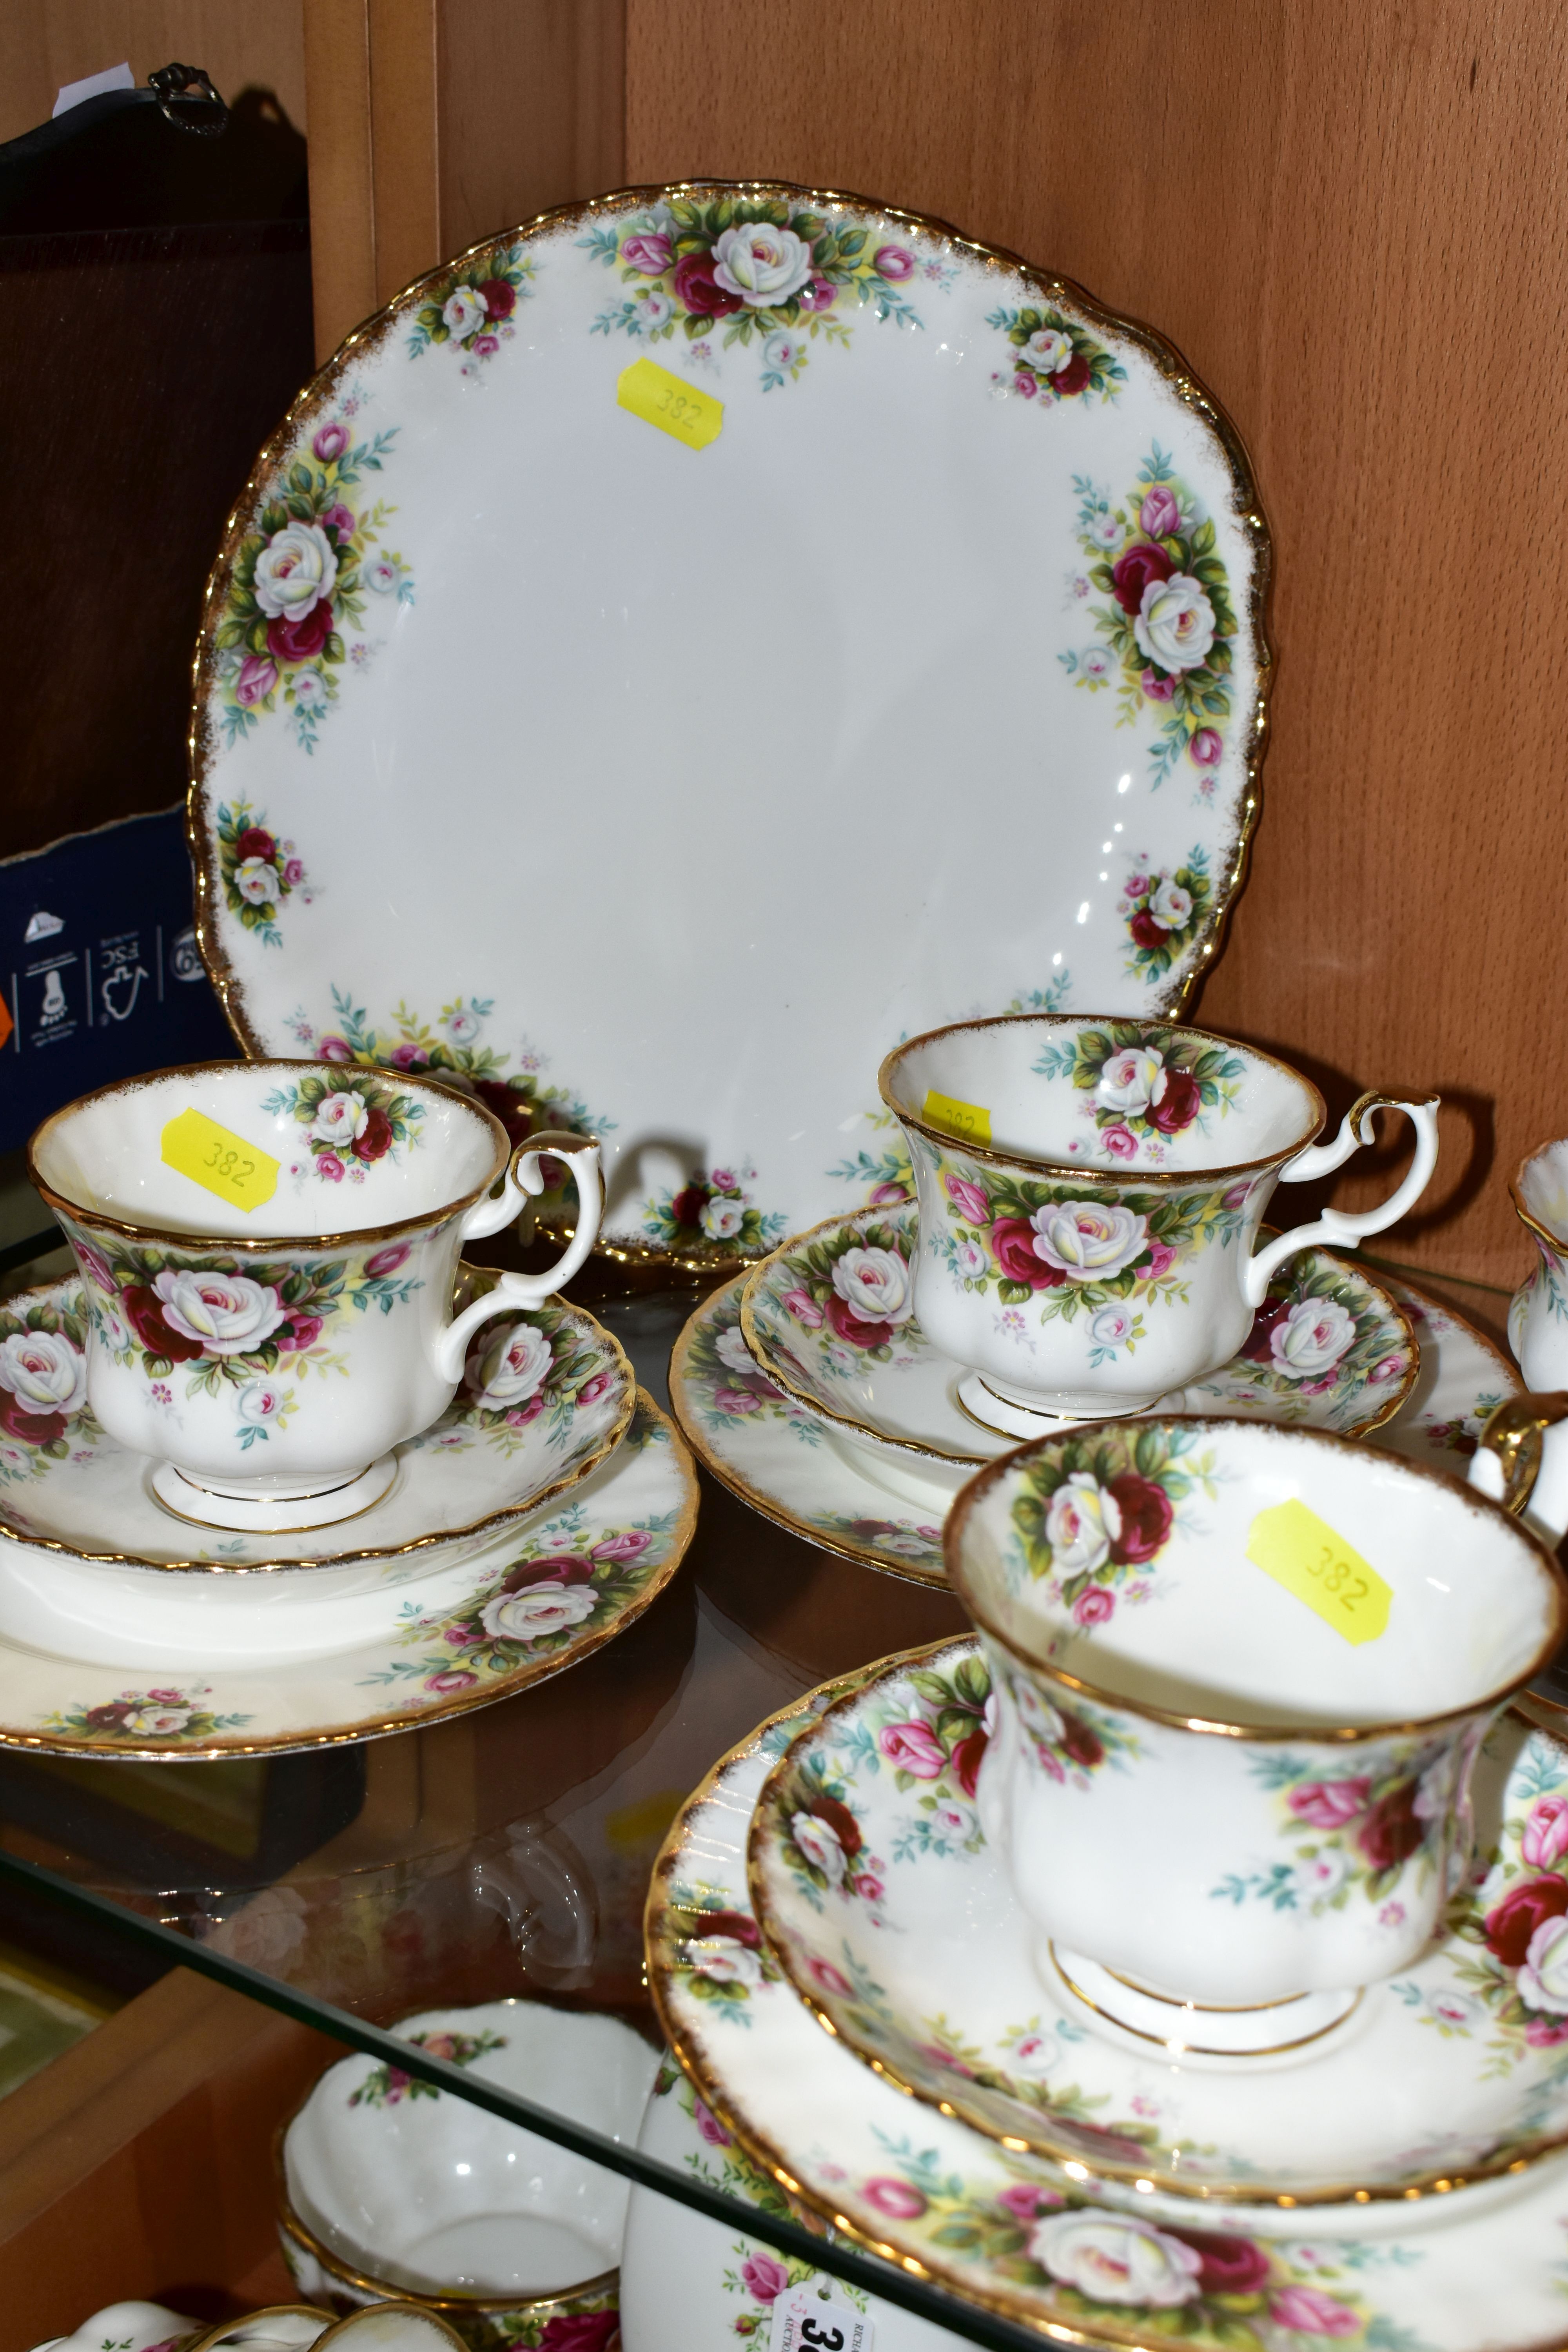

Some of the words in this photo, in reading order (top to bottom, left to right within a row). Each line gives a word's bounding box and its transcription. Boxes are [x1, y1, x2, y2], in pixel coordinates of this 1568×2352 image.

[656, 389, 702, 429] 382
[102, 941, 139, 969] FSC
[203, 1142, 256, 1187] 382
[1307, 1546, 1369, 1612] 382
[782, 2314, 793, 2352] AUCTIO
[798, 2318, 844, 2352] 3
